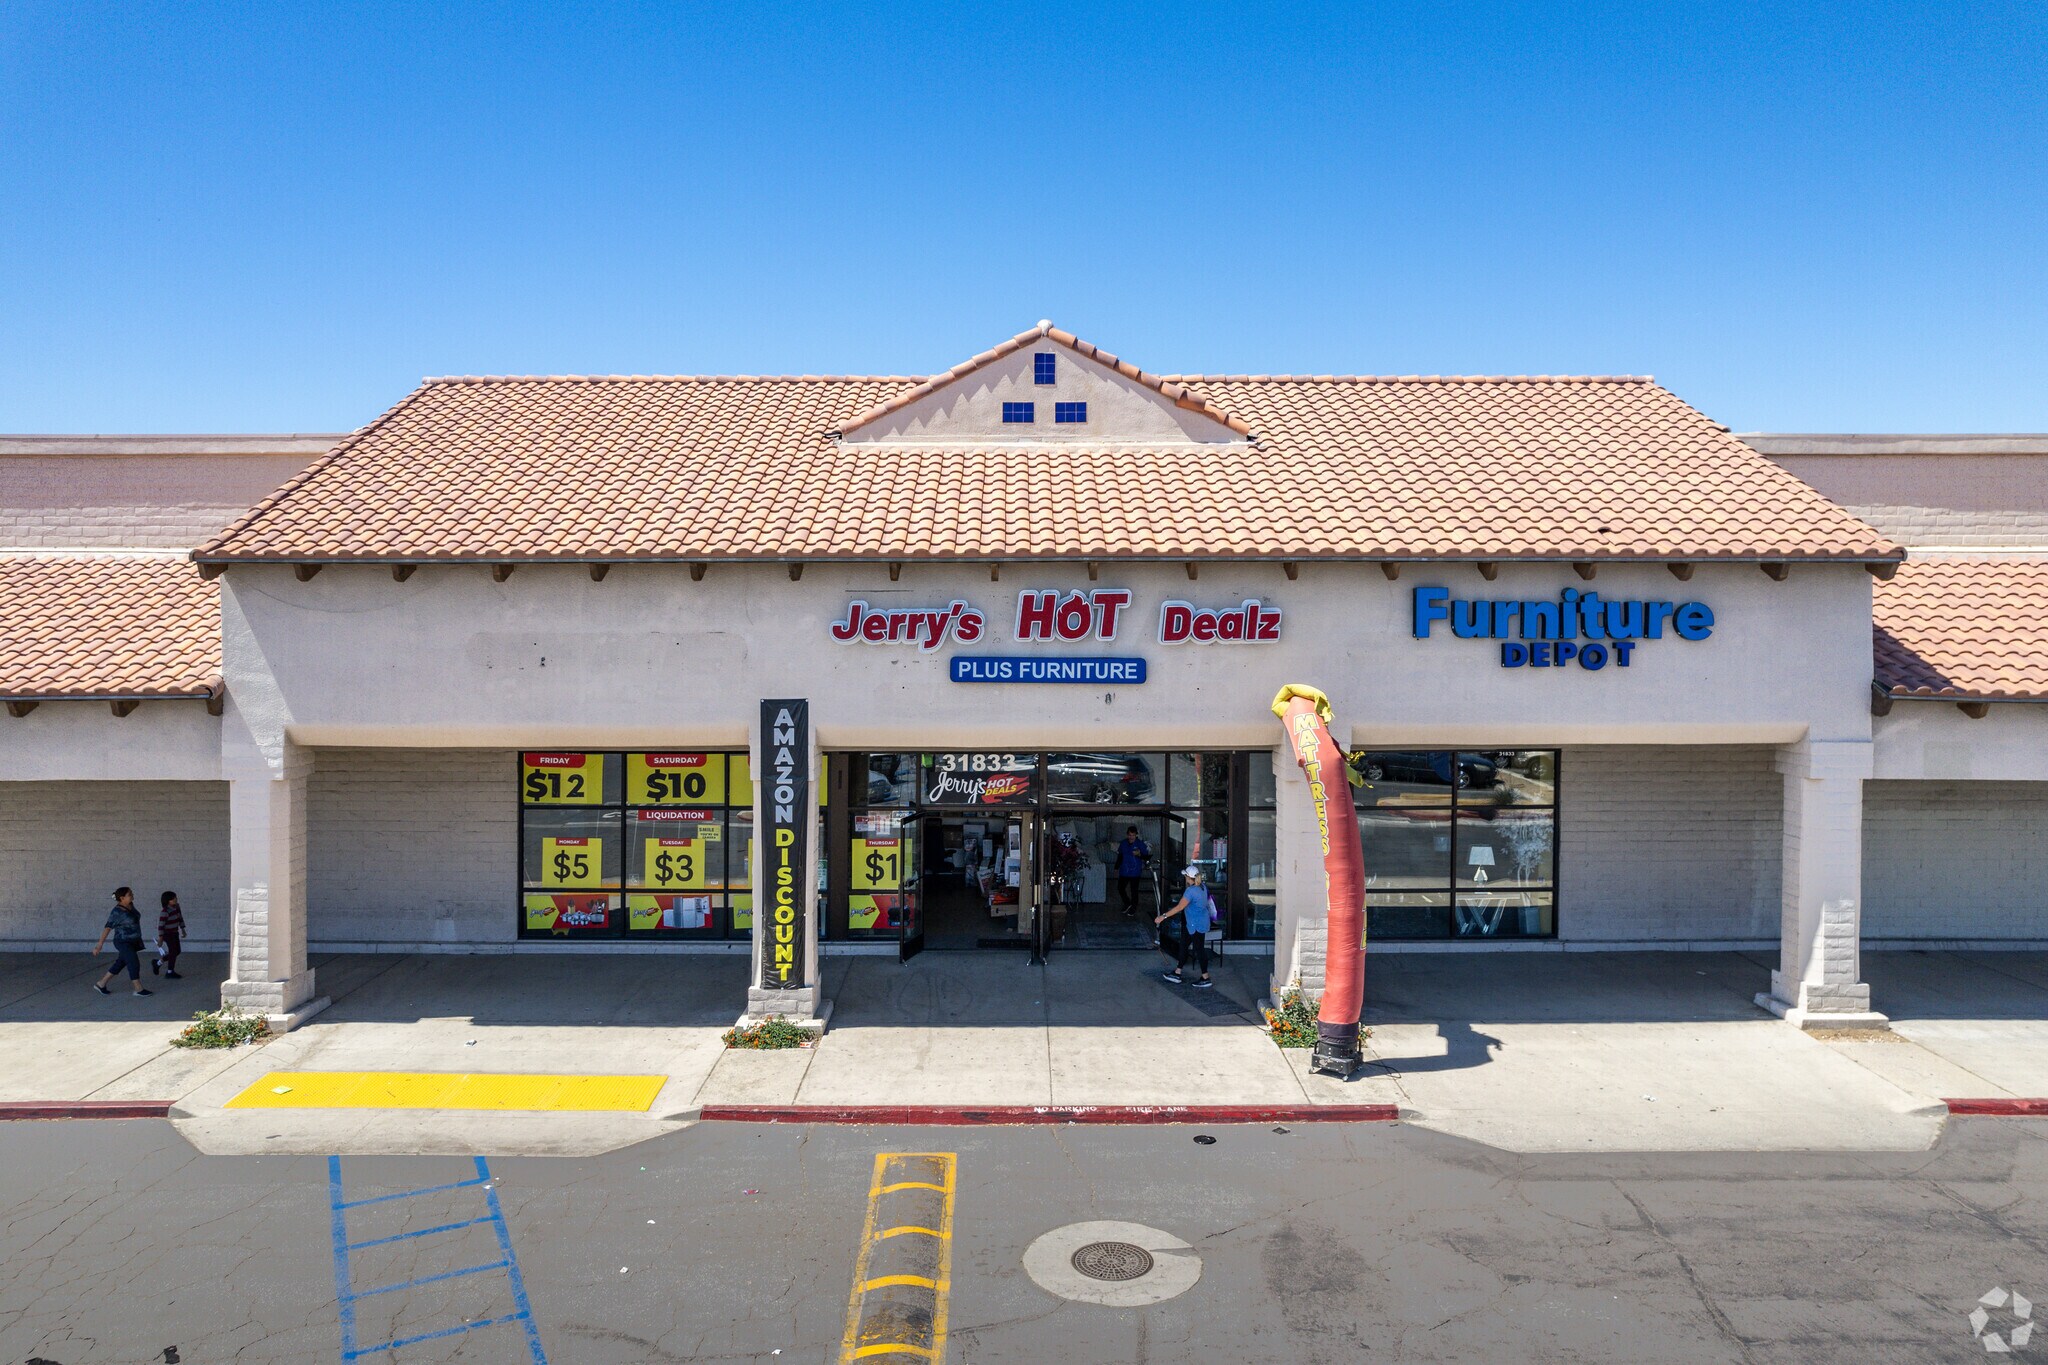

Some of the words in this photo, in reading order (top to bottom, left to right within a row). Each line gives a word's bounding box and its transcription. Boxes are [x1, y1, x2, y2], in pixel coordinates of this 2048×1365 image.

[831, 601, 984, 651] Jerry's
[1017, 591, 1131, 641] HOT
[1162, 602, 1282, 643] Dealz
[1412, 587, 1715, 641] Furniture
[958, 662, 1013, 680] PLUS
[1019, 662, 1138, 680] FURNITURE
[1501, 642, 1636, 671] DEPOT
[773, 708, 795, 824] AMAZON
[942, 754, 1016, 772] 31833
[526, 769, 585, 802] $12
[646, 769, 706, 802] $10
[929, 772, 987, 804] Jerry's
[984, 784, 1017, 796] DEALS
[987, 777, 1014, 789] HOT
[1293, 713, 1330, 857] MATTRESS
[646, 811, 705, 819] LIQUIDATION
[553, 850, 589, 883] $5
[654, 850, 694, 886] $3
[865, 849, 897, 886] $1
[774, 828, 795, 981] DISCOUNT
